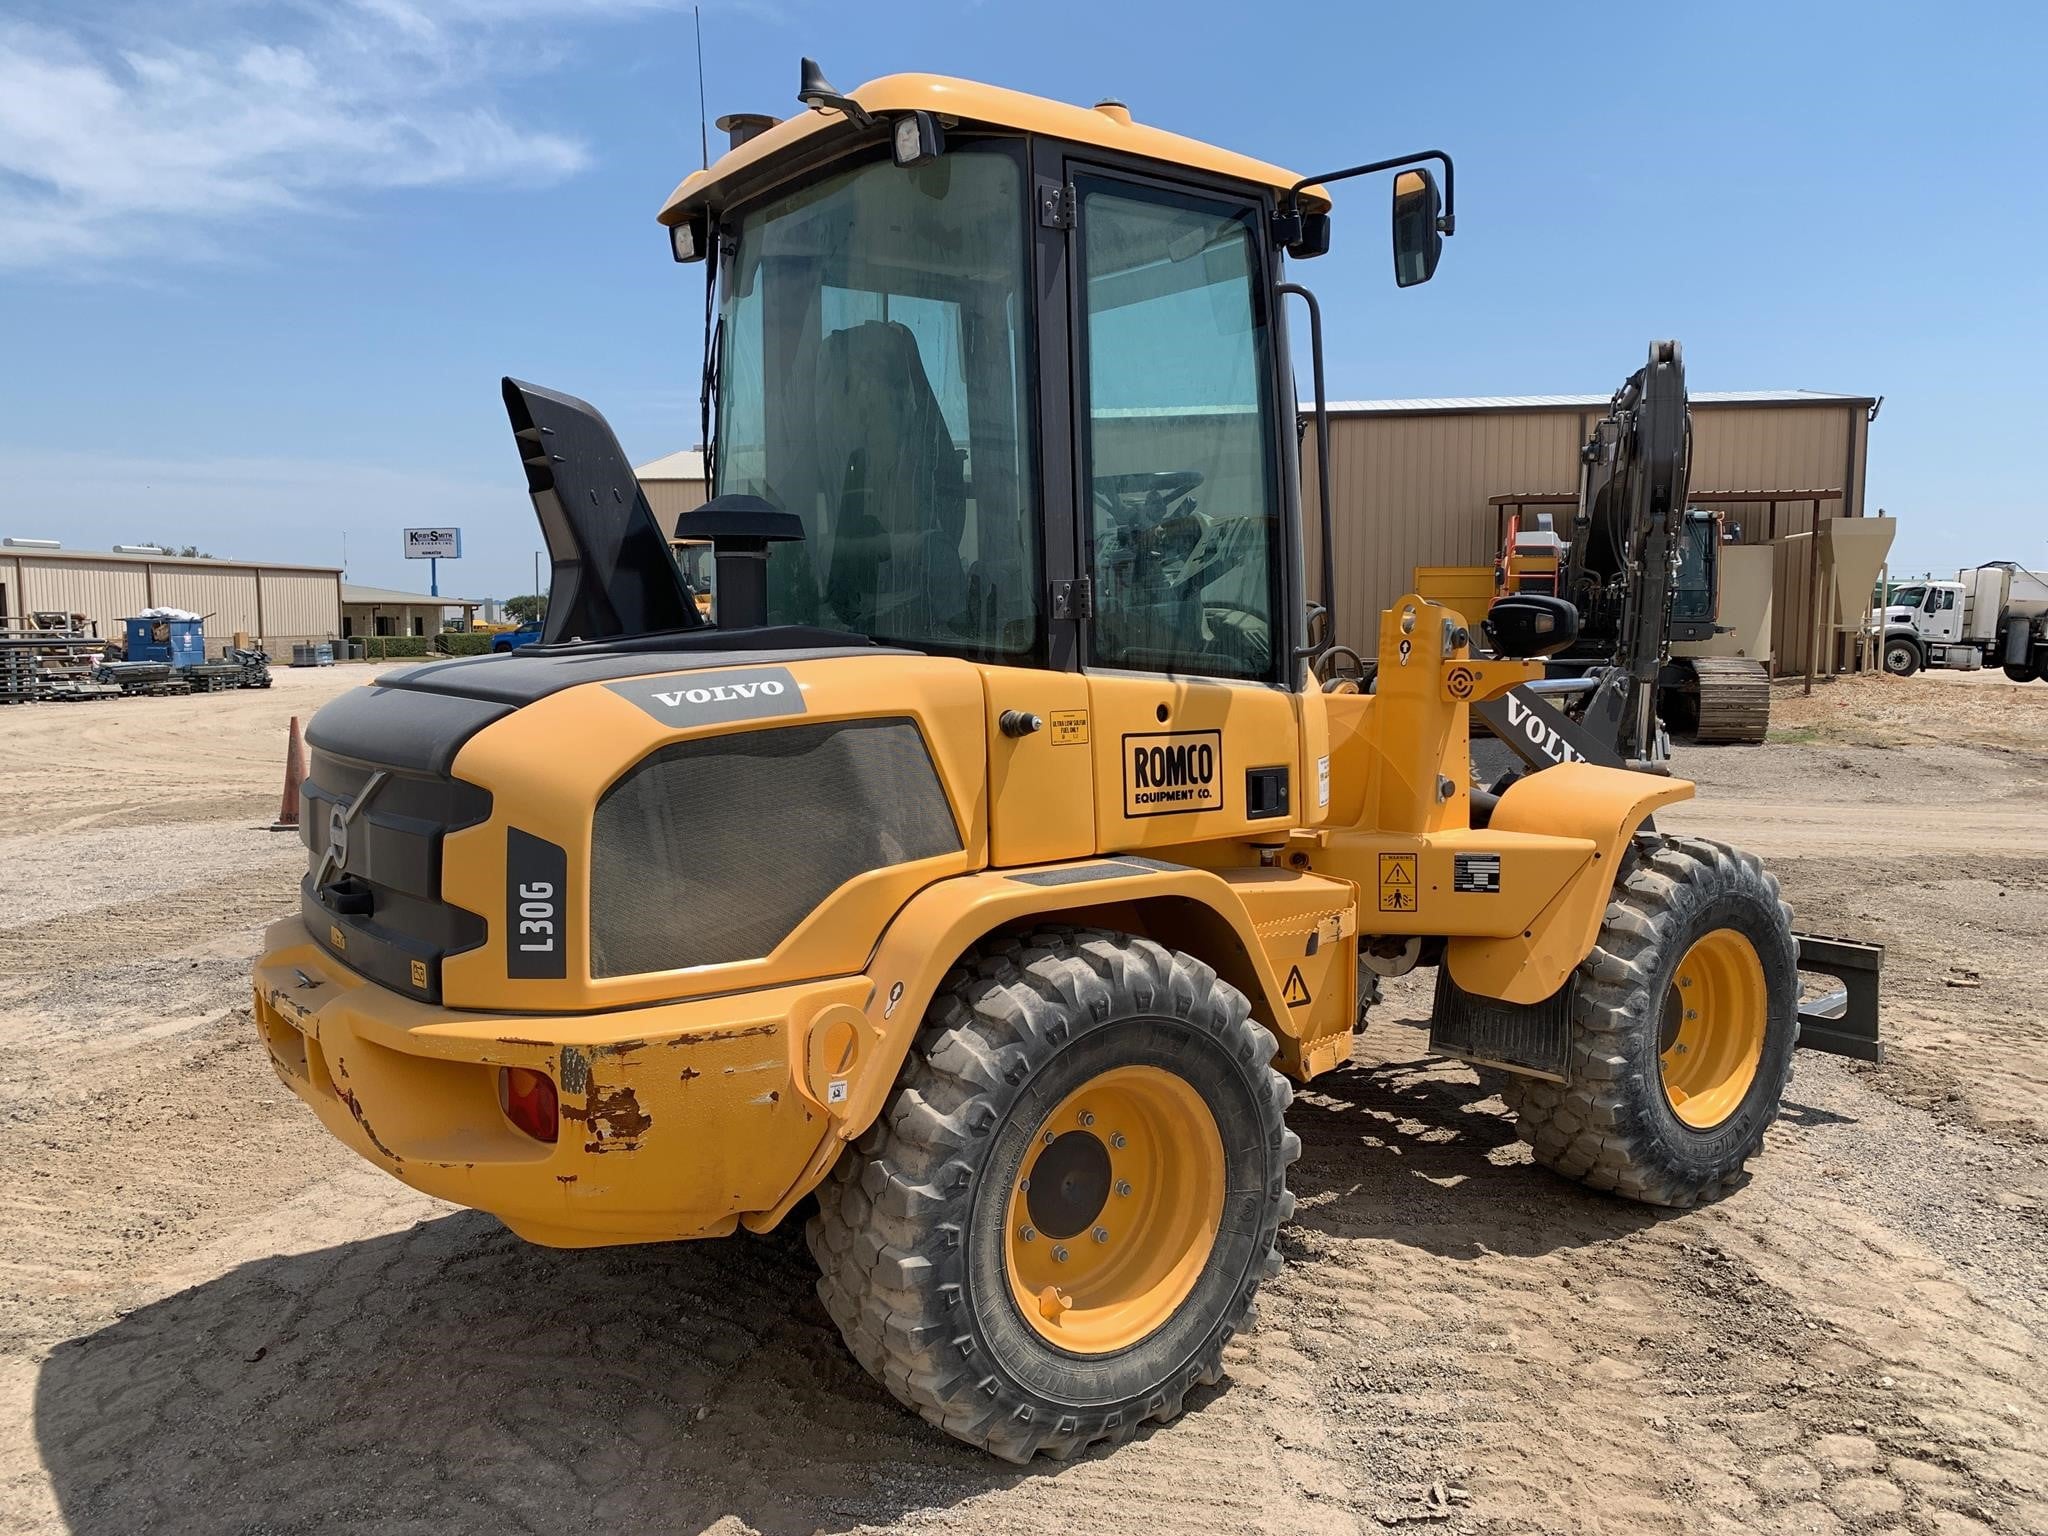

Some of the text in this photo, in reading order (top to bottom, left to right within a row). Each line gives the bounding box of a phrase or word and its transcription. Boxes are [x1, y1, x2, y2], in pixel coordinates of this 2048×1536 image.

[651, 680, 785, 707] VOLVO
[1505, 691, 1592, 765] VOLV
[1134, 743, 1213, 788] ROMCO
[1135, 788, 1212, 804] EQUIPMENT CO.
[519, 881, 554, 951] L30G
